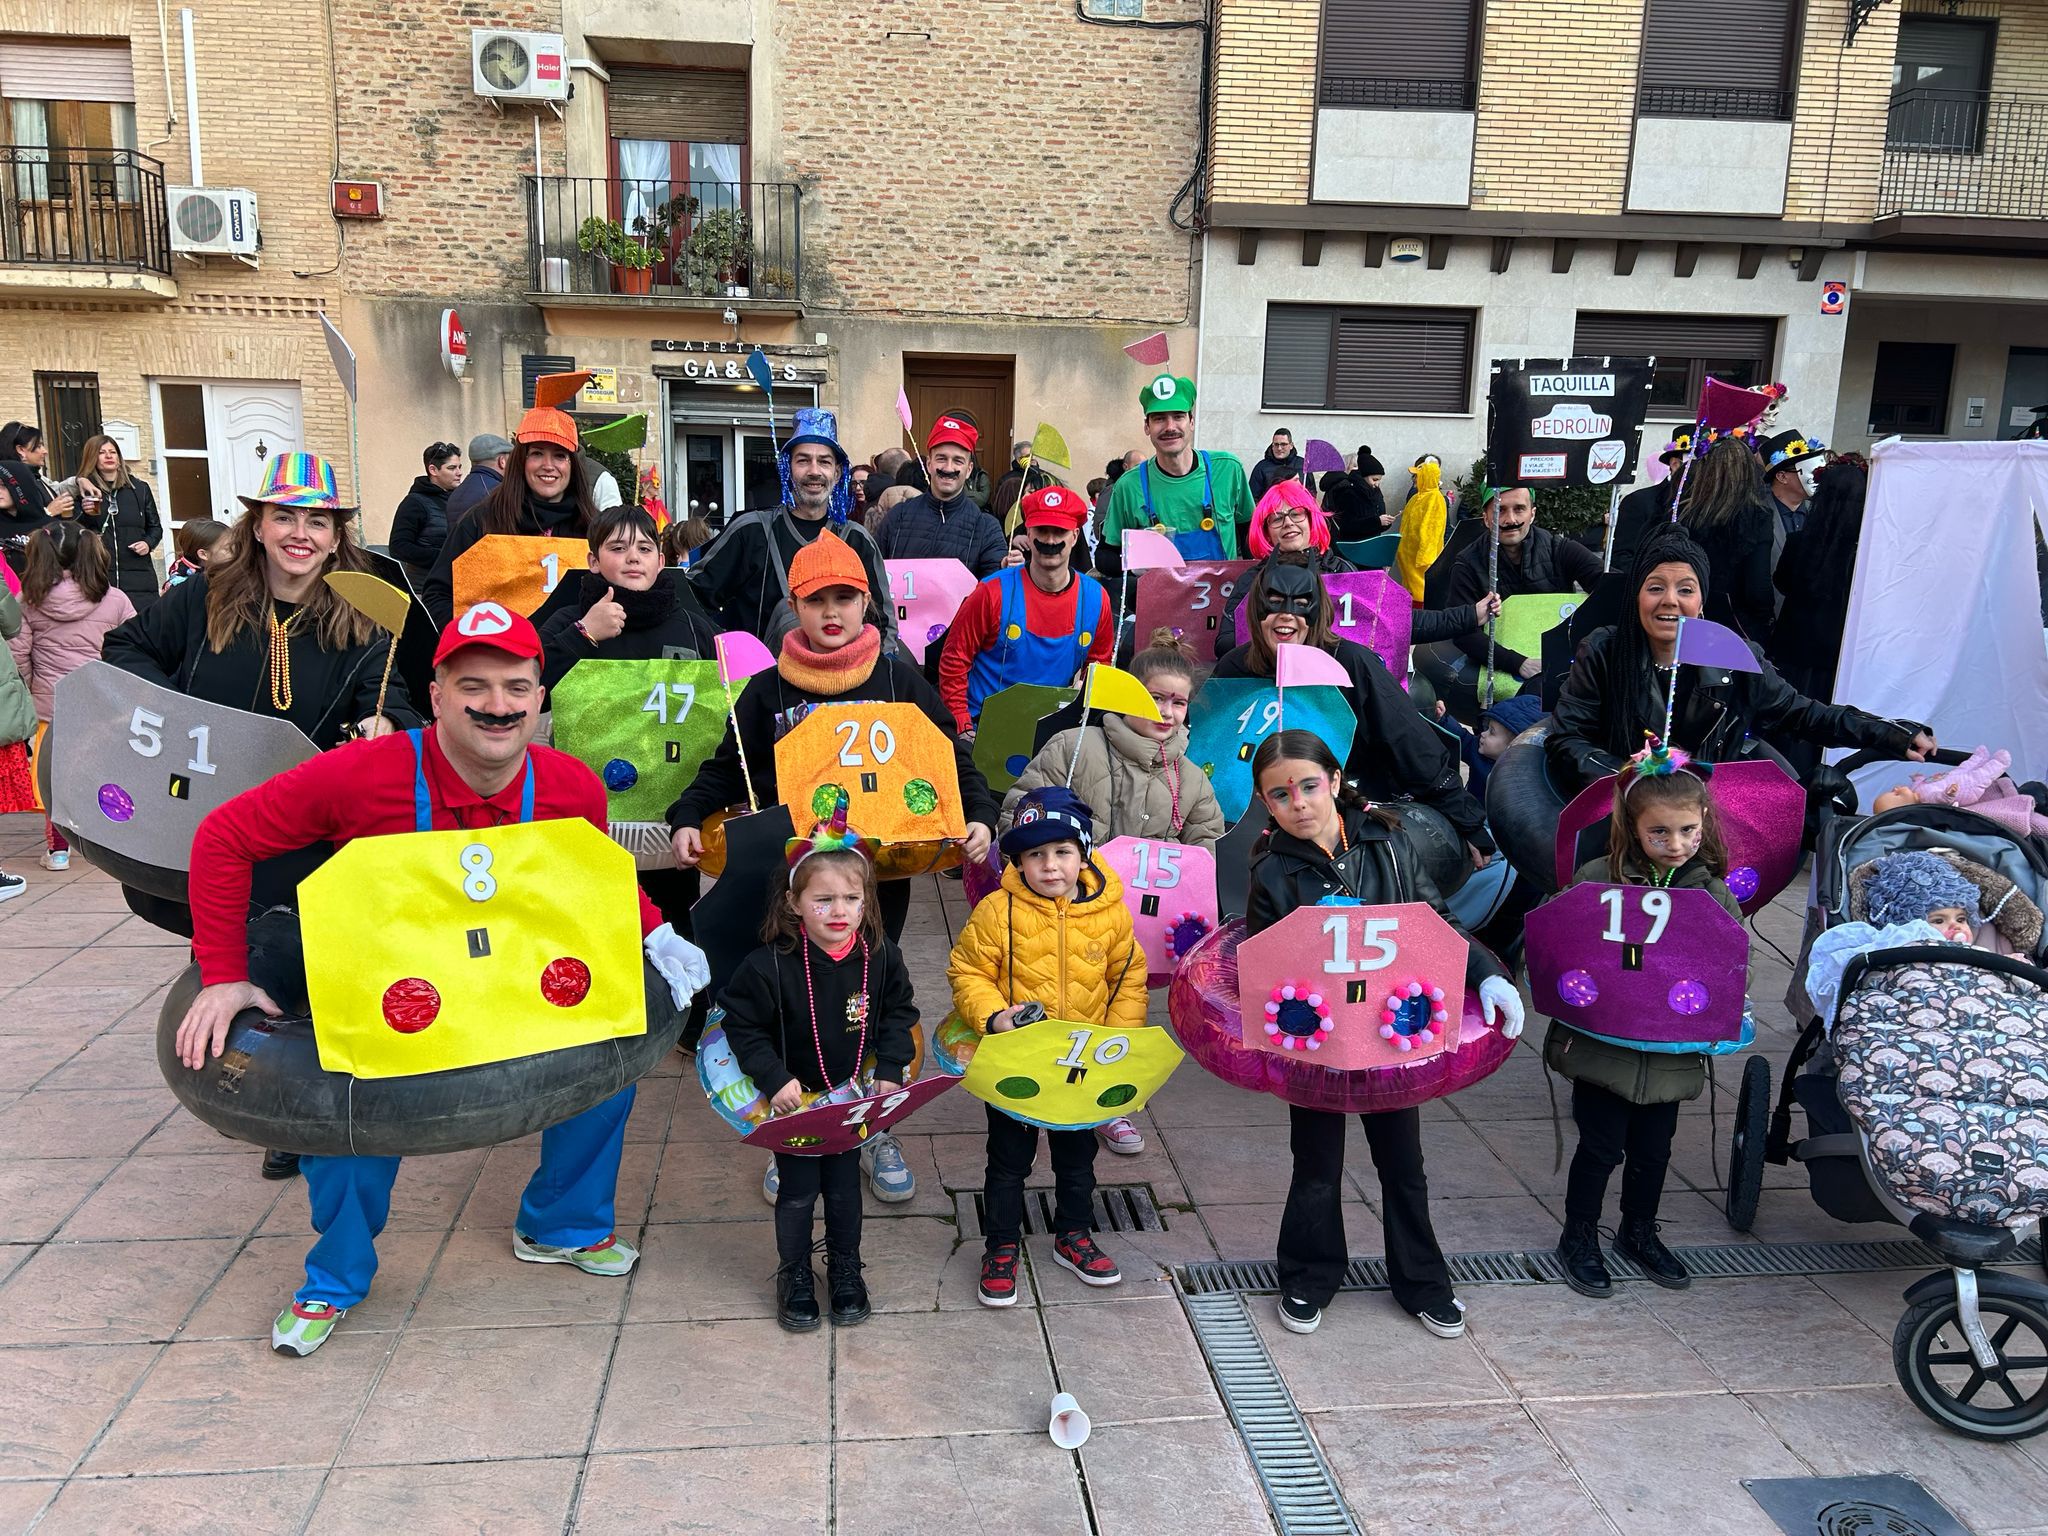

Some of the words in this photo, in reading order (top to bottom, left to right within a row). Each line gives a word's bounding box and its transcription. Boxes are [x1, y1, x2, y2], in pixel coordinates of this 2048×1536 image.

[537, 63, 560, 72] Haier
[232, 201, 241, 240] DAEWOO
[1159, 381, 1171, 396] L
[1531, 376, 1610, 394] TAQUILLA
[1532, 417, 1610, 436] PEDROLIN
[1046, 494, 1060, 504] M
[469, 609, 507, 631] M
[642, 681, 696, 724] 47
[835, 718, 897, 768] 20
[460, 843, 498, 902] 8
[1131, 842, 1183, 891] 15
[1600, 888, 1672, 944] 19
[1321, 914, 1400, 974] 15
[1056, 1030, 1131, 1069] 10
[841, 1091, 911, 1126] 19
